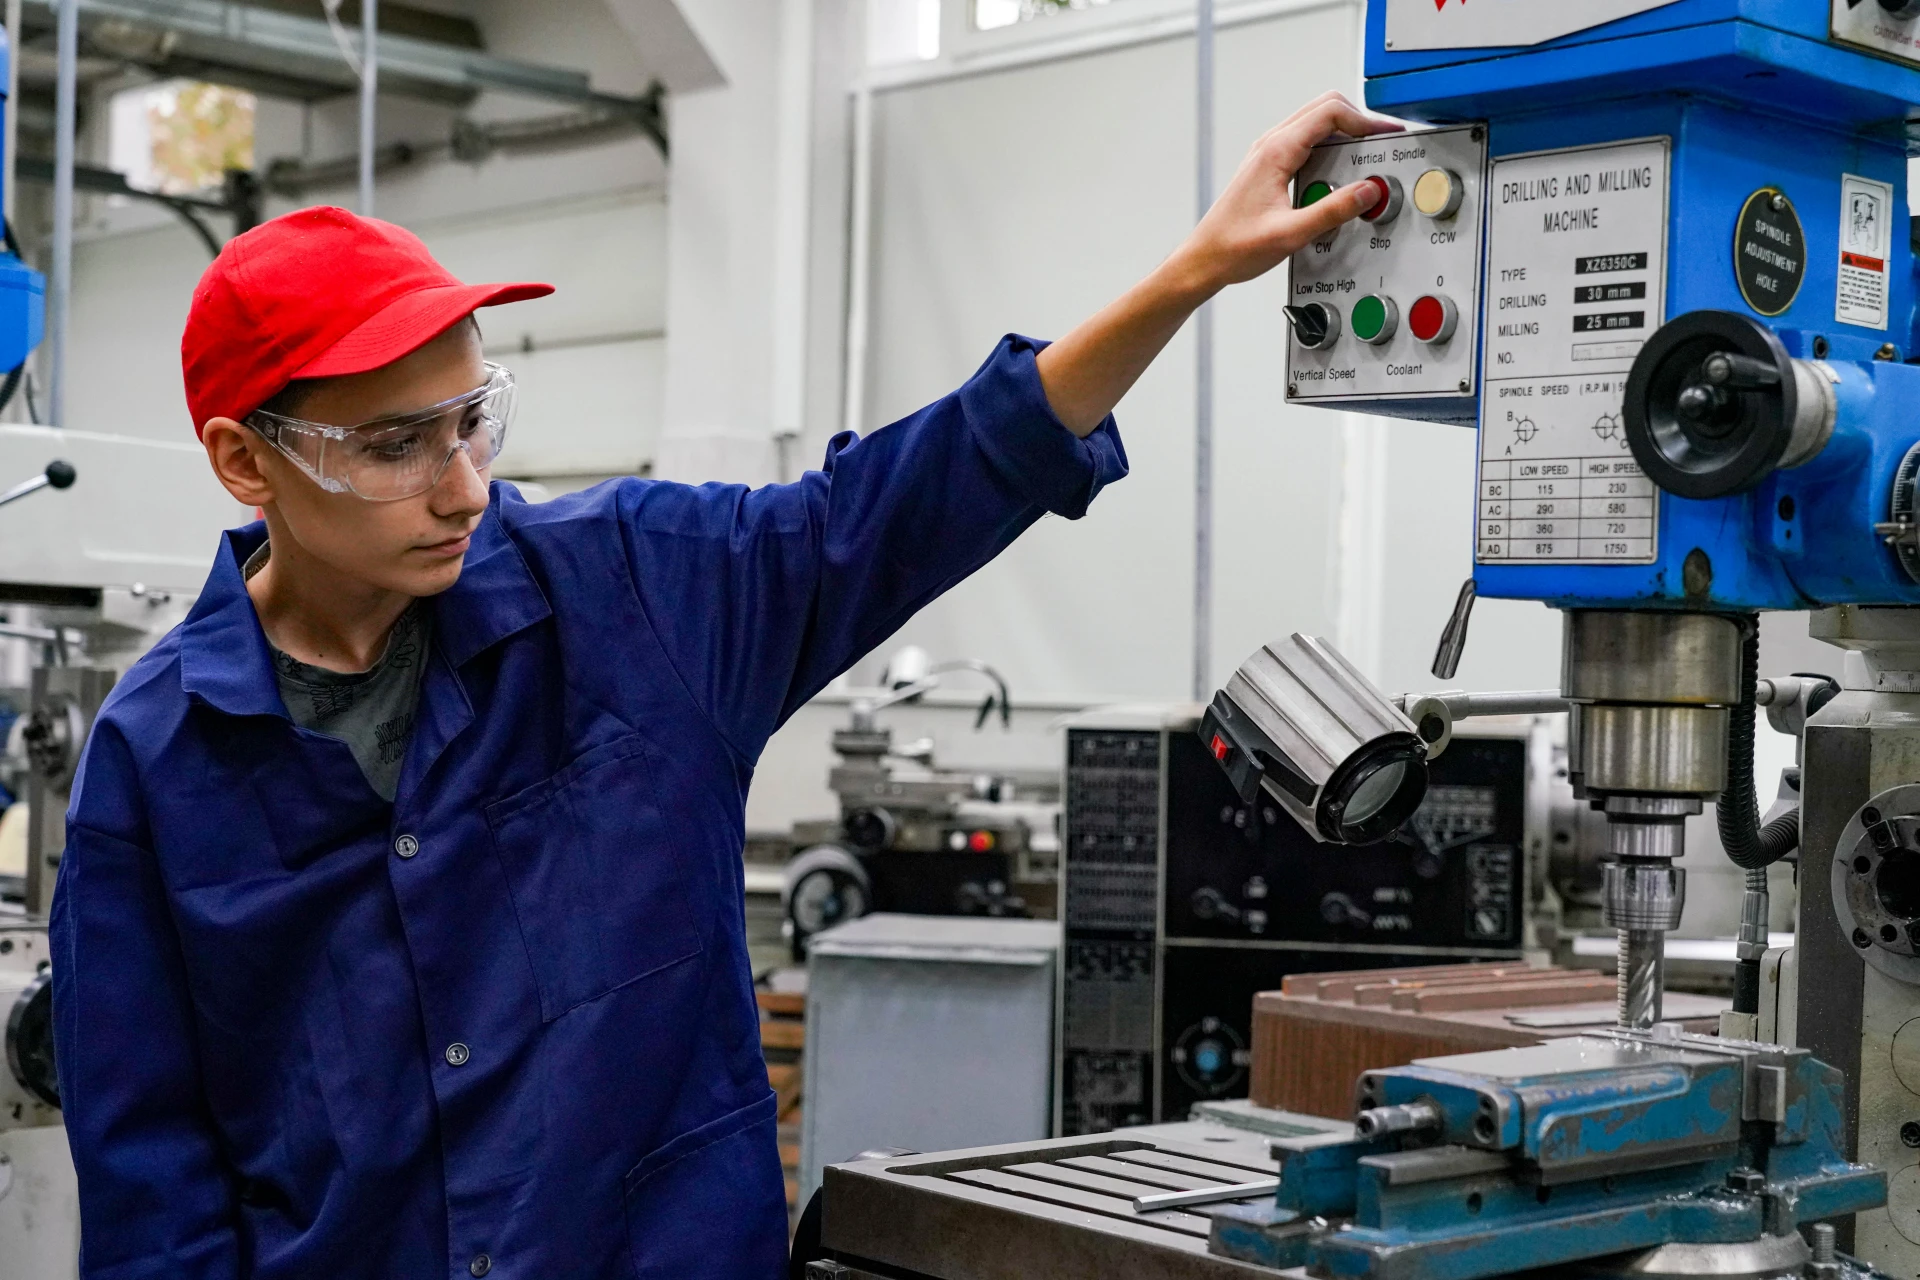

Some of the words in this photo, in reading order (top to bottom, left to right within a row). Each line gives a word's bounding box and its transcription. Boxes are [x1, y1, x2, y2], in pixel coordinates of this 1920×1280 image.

[1351, 151, 1386, 166] Vertical
[1392, 147, 1426, 163] Spindle
[1503, 177, 1558, 204] DRILLING
[1564, 174, 1591, 197] AND
[1598, 167, 1652, 193] MILLING
[1543, 207, 1599, 233] MACHINE
[1430, 232, 1456, 245] CCW
[1755, 219, 1792, 246] SPINDLE
[1315, 242, 1332, 254] CW
[1370, 237, 1391, 251] Stop
[1585, 255, 1637, 272] XZ6350C
[1744, 241, 1798, 274] ADJUSTMENT
[1501, 268, 1527, 282] TYPE
[1296, 282, 1314, 295] Low
[1315, 280, 1335, 294] Stop
[1336, 279, 1356, 293] High
[1755, 273, 1778, 293] HOLE
[1588, 287, 1602, 301] 30
[1608, 286, 1631, 298] mm
[1500, 294, 1546, 310] DRILLING
[1586, 316, 1602, 329] 25
[1607, 316, 1630, 327] mm
[1498, 322, 1539, 337] MILLING
[1497, 352, 1515, 364] NO.
[1293, 369, 1326, 381] Vertical
[1328, 368, 1356, 381] Speed
[1386, 364, 1423, 376] Coolant
[1499, 386, 1532, 398] SPINDLE
[1541, 384, 1569, 395] SPEED
[1507, 411, 1513, 422] B
[1505, 446, 1512, 456] A
[1520, 466, 1538, 476] LOW
[1541, 465, 1569, 475] SPEED
[1589, 463, 1609, 474] HIGH
[1489, 485, 1502, 496] BC
[1538, 484, 1553, 495] 115
[1608, 483, 1627, 494] 230
[1488, 505, 1502, 515] AC
[1536, 504, 1554, 514] 290
[1607, 503, 1626, 514] 580
[1488, 524, 1502, 535] BD
[1536, 524, 1553, 534] 360
[1607, 523, 1626, 534] 720
[1487, 544, 1500, 554] AD
[1536, 543, 1553, 554] 875
[1604, 543, 1627, 554] 1750
